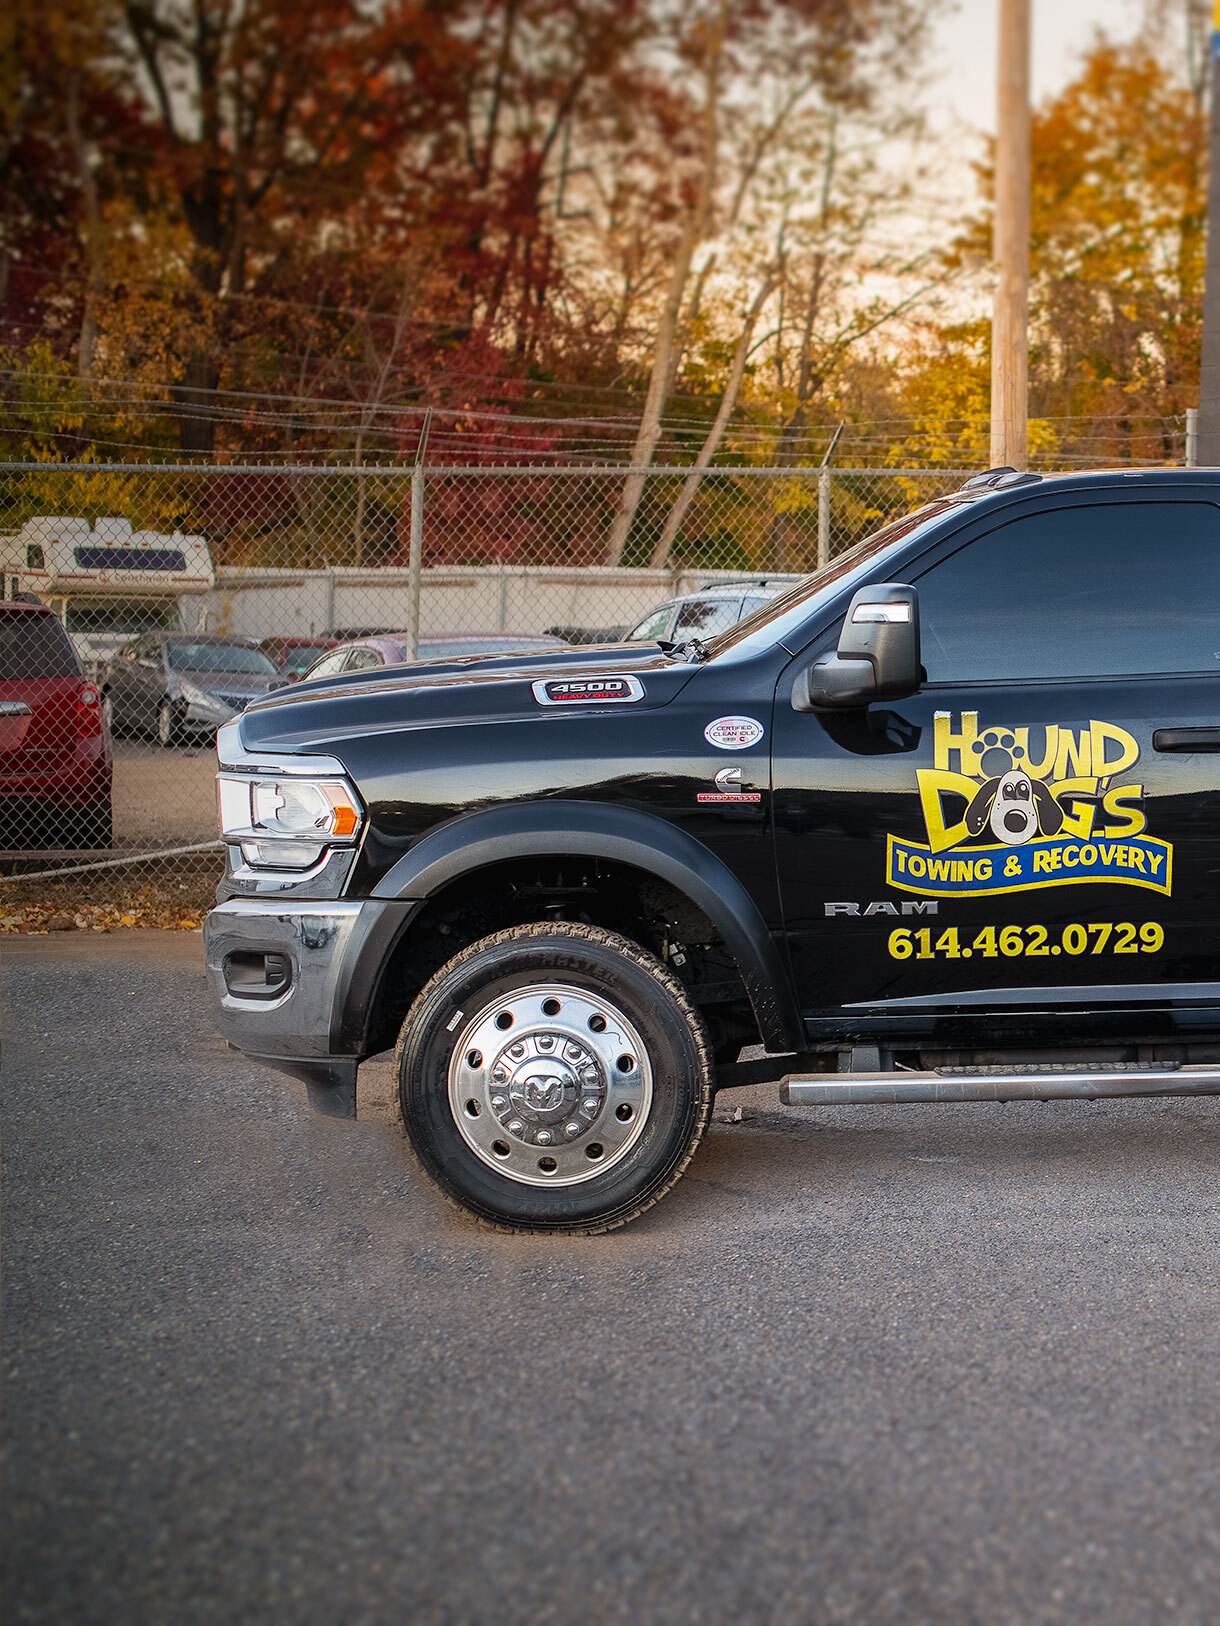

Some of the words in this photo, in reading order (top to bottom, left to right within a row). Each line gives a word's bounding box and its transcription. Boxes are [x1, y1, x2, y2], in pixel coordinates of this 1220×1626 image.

[551, 681, 623, 693] 4500
[552, 692, 593, 700] HEAVY
[933, 710, 1141, 781] HOUND
[895, 849, 993, 882] TOWING
[1003, 855, 1023, 877] &
[1033, 843, 1164, 875] RECOVERY
[824, 900, 939, 916] RAM
[888, 921, 1165, 959] 614.462.0729
